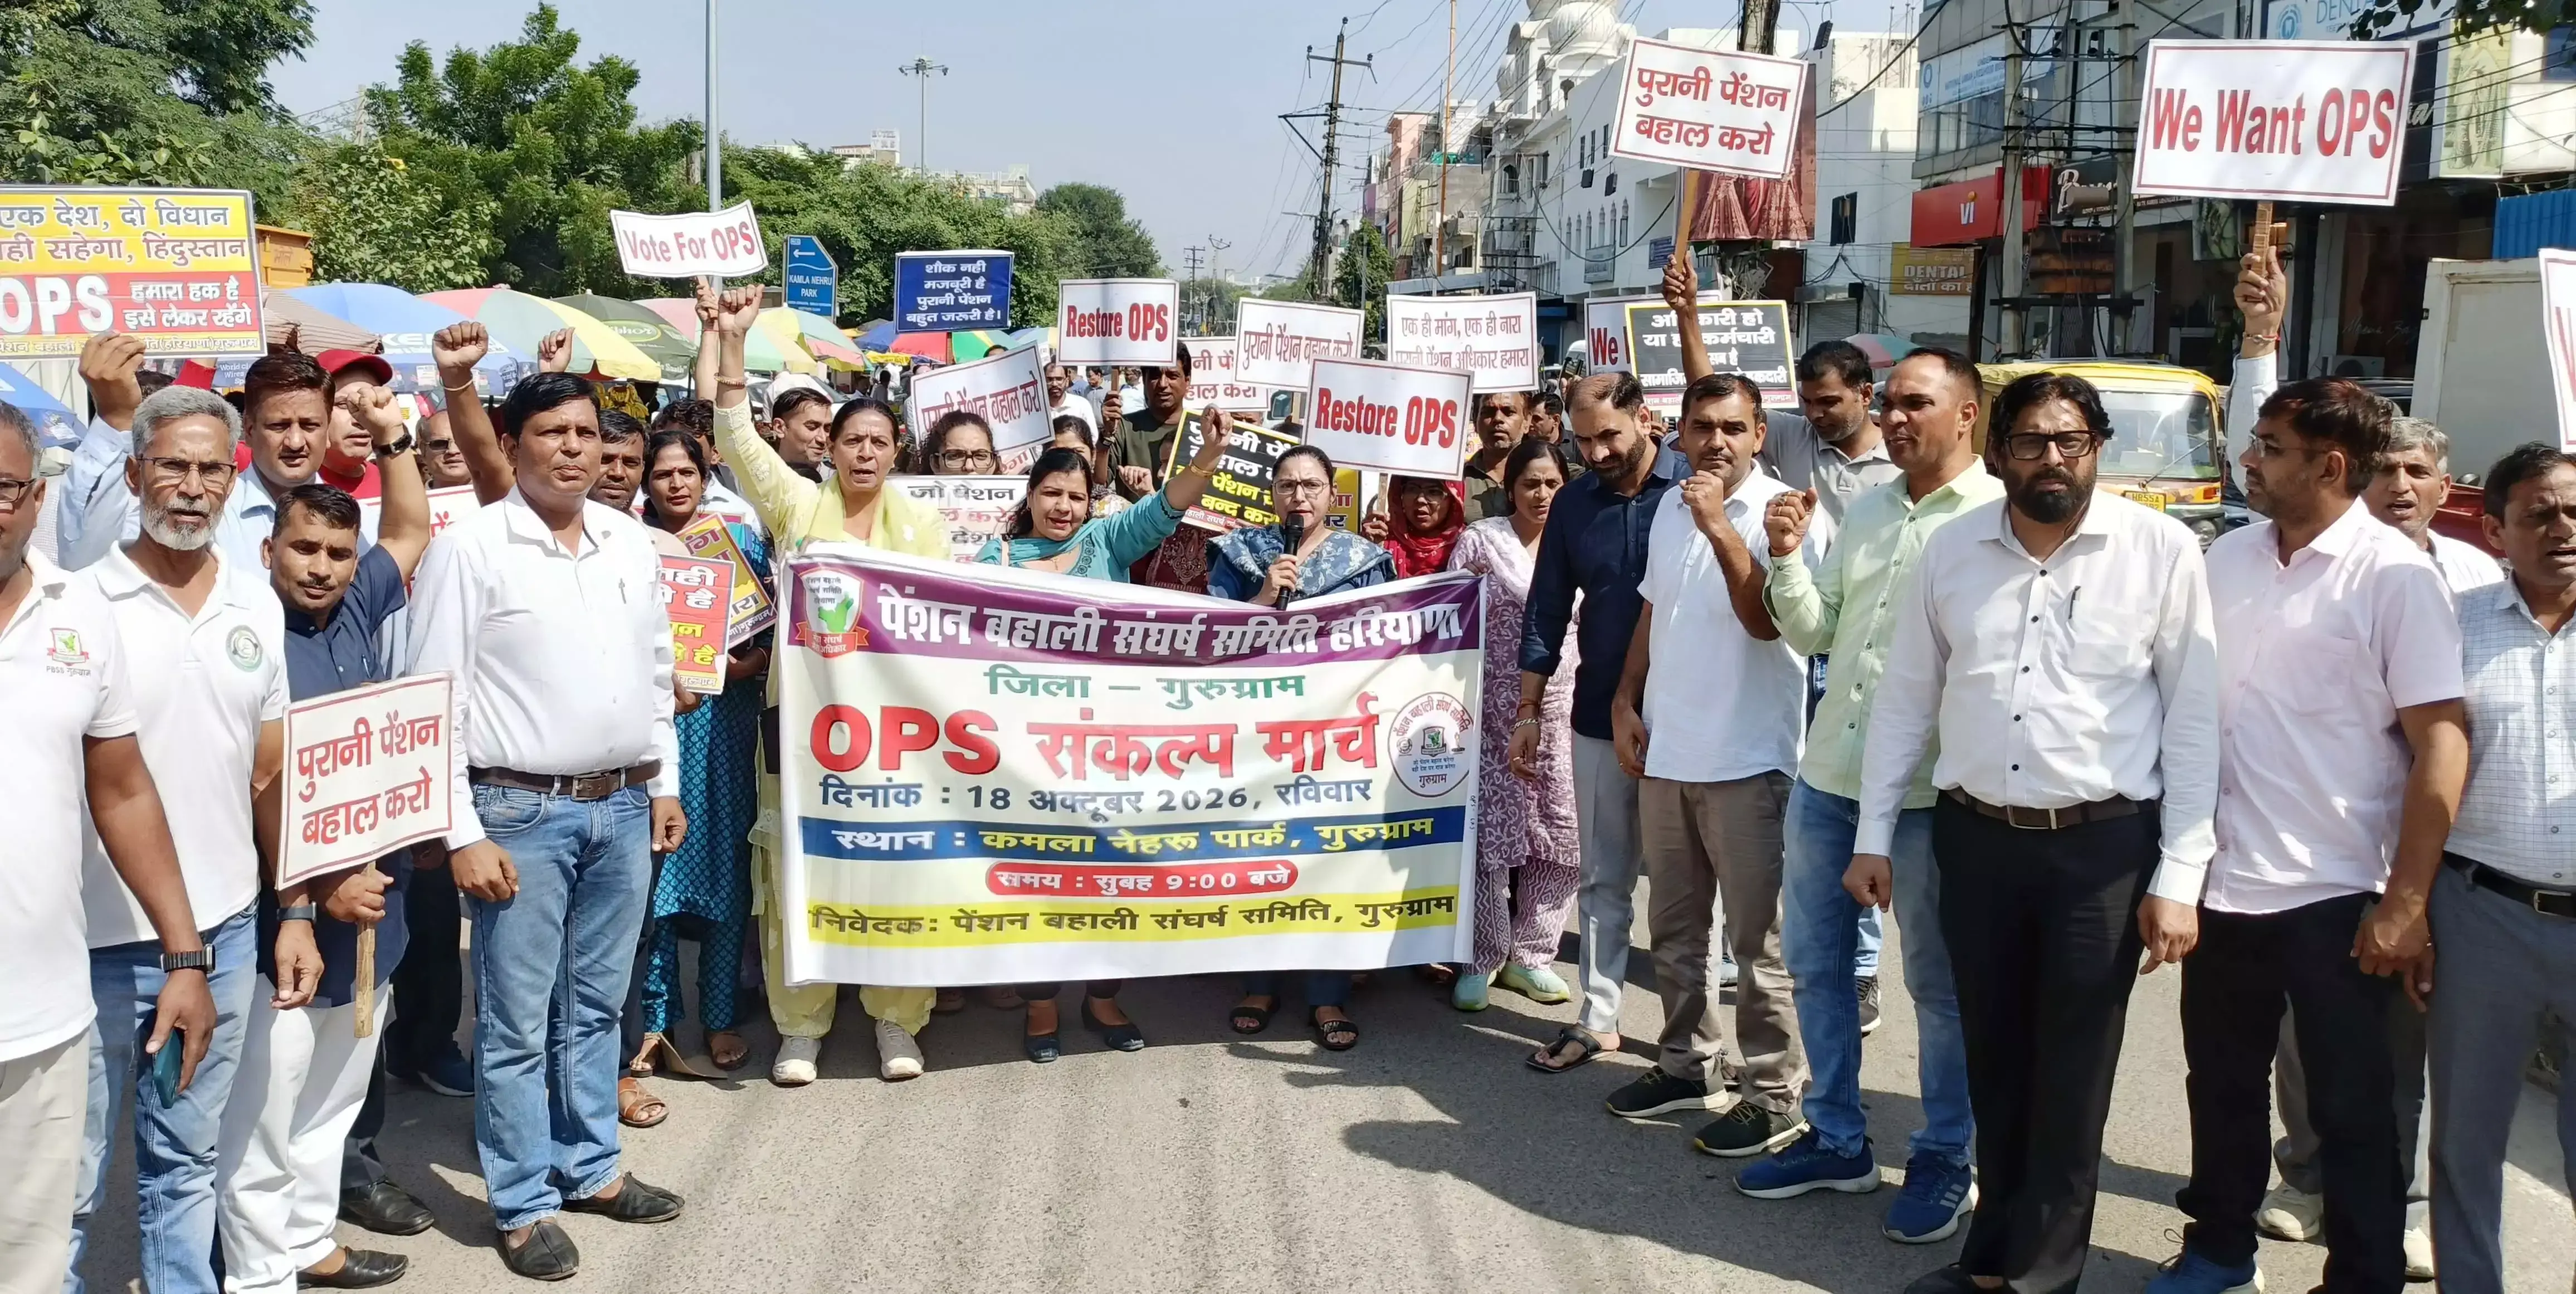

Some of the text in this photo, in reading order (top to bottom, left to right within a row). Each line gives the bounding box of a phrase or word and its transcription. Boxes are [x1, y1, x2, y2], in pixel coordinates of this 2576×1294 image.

[1635, 65, 1790, 112] पुरानी पेंशन
[1635, 113, 1775, 156] बहाल करो
[2152, 87, 2395, 159] We Want OPS
[0, 198, 228, 231] एक देश, दो विधान
[0, 231, 246, 266] ही सहेगा, हिंदुस्तान
[623, 221, 755, 262] Vote For OPS
[789, 274, 832, 285] KAMLA NEHRU
[925, 260, 986, 273] शौक नही
[1904, 265, 1967, 278] DENTAL
[129, 275, 240, 302] हमारा हक है
[801, 288, 818, 298] PARK
[924, 276, 986, 293] मजबूरी है
[0, 275, 114, 335] OPS
[123, 303, 156, 330] इसे
[160, 303, 209, 328] लेकर
[906, 313, 939, 327] बहुत
[941, 308, 982, 322] जरूरी
[916, 293, 992, 310] पुरानी पेंशन
[1739, 308, 1764, 327] हो
[1066, 303, 1168, 342] Restore OPS
[1401, 317, 1418, 337] एक
[1421, 312, 1432, 338] ही
[1464, 318, 1482, 337] एक
[1485, 311, 1497, 337] ही
[1499, 315, 1521, 335] नारा
[1243, 323, 1274, 370] पुरानी
[1275, 324, 1303, 363] पेंशन
[1591, 327, 1619, 366] We
[1642, 334, 1667, 347] या
[1455, 345, 1498, 370] अधिकार
[1500, 347, 1530, 369] हमारा
[989, 386, 1021, 425] बहाल
[1021, 370, 1041, 415] करो
[1315, 387, 1398, 437] Restore
[1404, 395, 1458, 449] OPS
[1212, 471, 1260, 500] पेंशन
[1201, 494, 1241, 517] बन्द
[685, 588, 718, 609] है
[877, 583, 1464, 656] पेंशन बहाली संघर्ष समिति हरियाणा
[692, 643, 718, 665] है
[983, 663, 1091, 698] जिला
[1156, 673, 1305, 709] गुरुग्राम
[810, 691, 1379, 781] OPS संकल्प मार्च
[297, 708, 443, 802] पुरानी पेंशन
[1419, 774, 1448, 788] गुरुग्राम
[301, 765, 433, 845] बहाल करो
[819, 774, 923, 808] दिनांक
[967, 785, 1011, 810] 18
[1028, 789, 1143, 823] अक्टूबर
[1157, 787, 1261, 812] 2026,
[1274, 774, 1373, 806] रविवार
[831, 829, 935, 852] स्थान
[978, 830, 1097, 853] कमला
[1108, 828, 1199, 855] नेहरू
[1210, 821, 1301, 849] पार्क,
[1314, 817, 1433, 851] गुरुग्राम
[994, 870, 1062, 889] समय
[1092, 873, 1154, 896] सुबह
[1165, 872, 1237, 890] 9:00
[1247, 864, 1291, 886] बजे
[950, 908, 1030, 933] पेंशन
[1039, 907, 1140, 931] बहाली
[1150, 904, 1230, 930] संघर्ष
[1239, 898, 1343, 923] समिति,
[1355, 895, 1455, 928] गुरुग्राम
